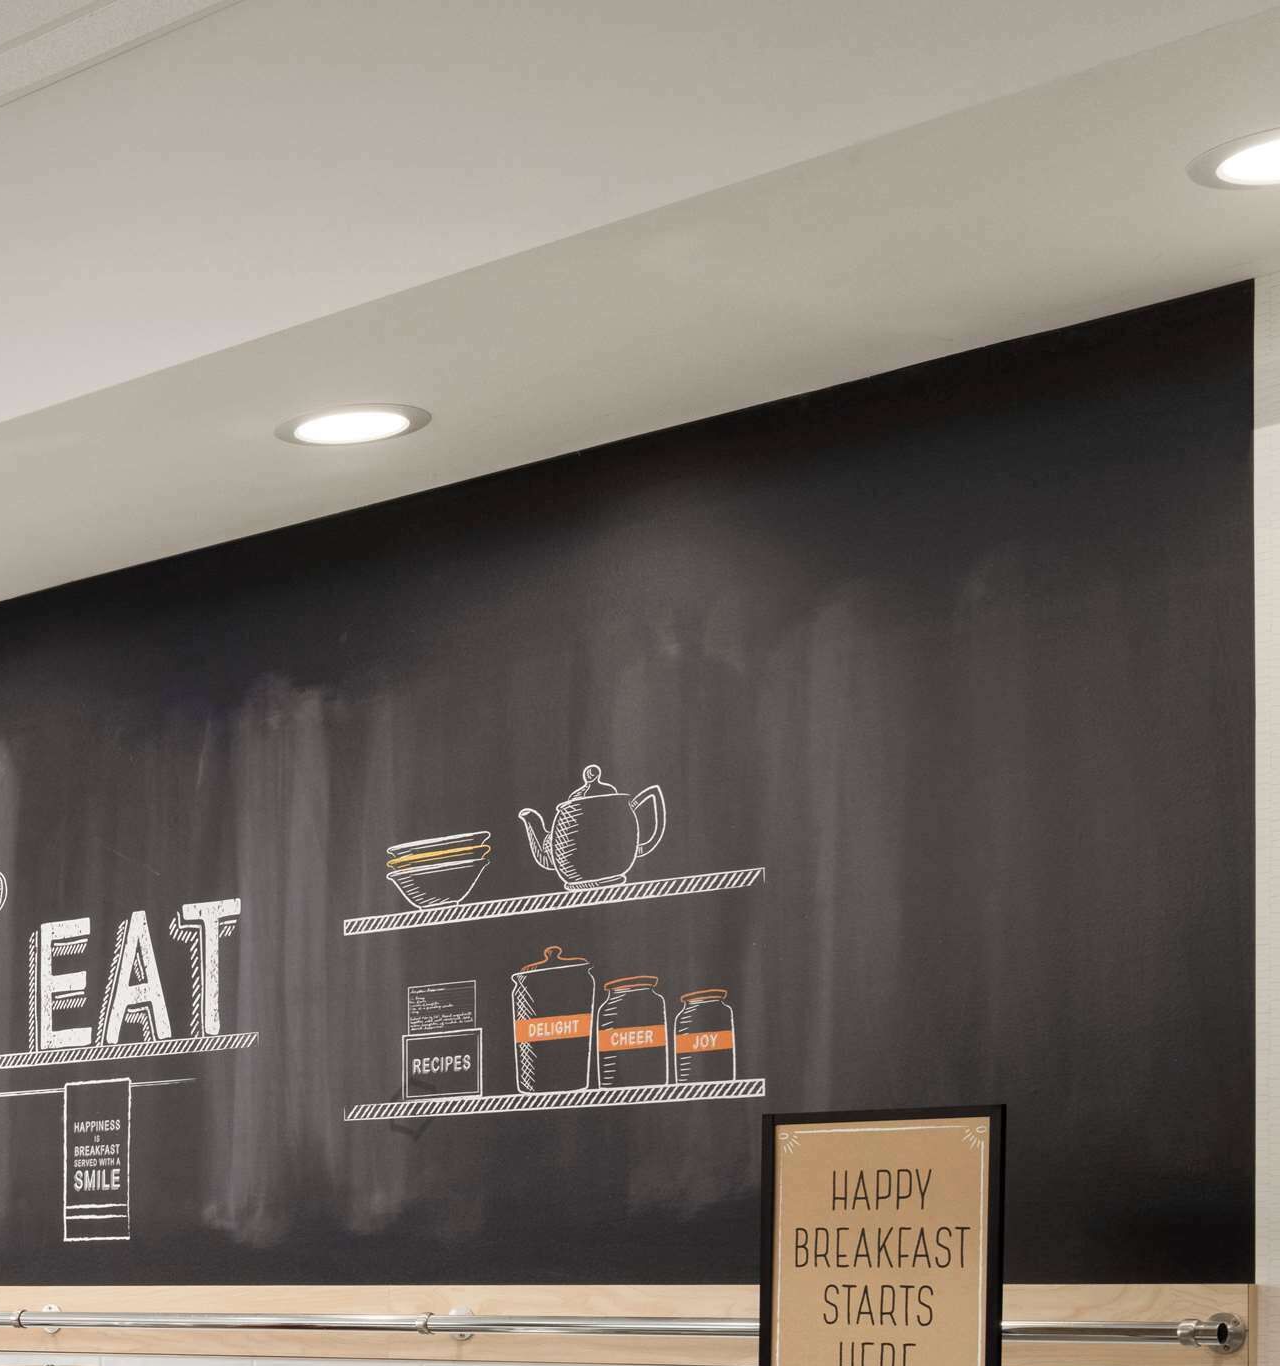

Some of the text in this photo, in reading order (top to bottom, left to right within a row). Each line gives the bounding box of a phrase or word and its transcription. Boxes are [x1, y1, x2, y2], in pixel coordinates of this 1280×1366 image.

[31, 899, 241, 1050] EAT
[528, 1019, 580, 1038] DELIGHT
[610, 1031, 654, 1047] CHEER
[692, 1033, 719, 1049] JOY
[412, 1054, 472, 1075] RECIPES
[74, 1119, 121, 1133] HAPPINESS
[93, 1135, 101, 1143] IS
[74, 1143, 121, 1157] BREAKFAST
[74, 1157, 121, 1168] SERVED WITH A
[74, 1168, 121, 1192] SMILE
[832, 1168, 932, 1210] HAPPY
[795, 1226, 971, 1268] BREAKFAST
[823, 1284, 934, 1326] STARTS
